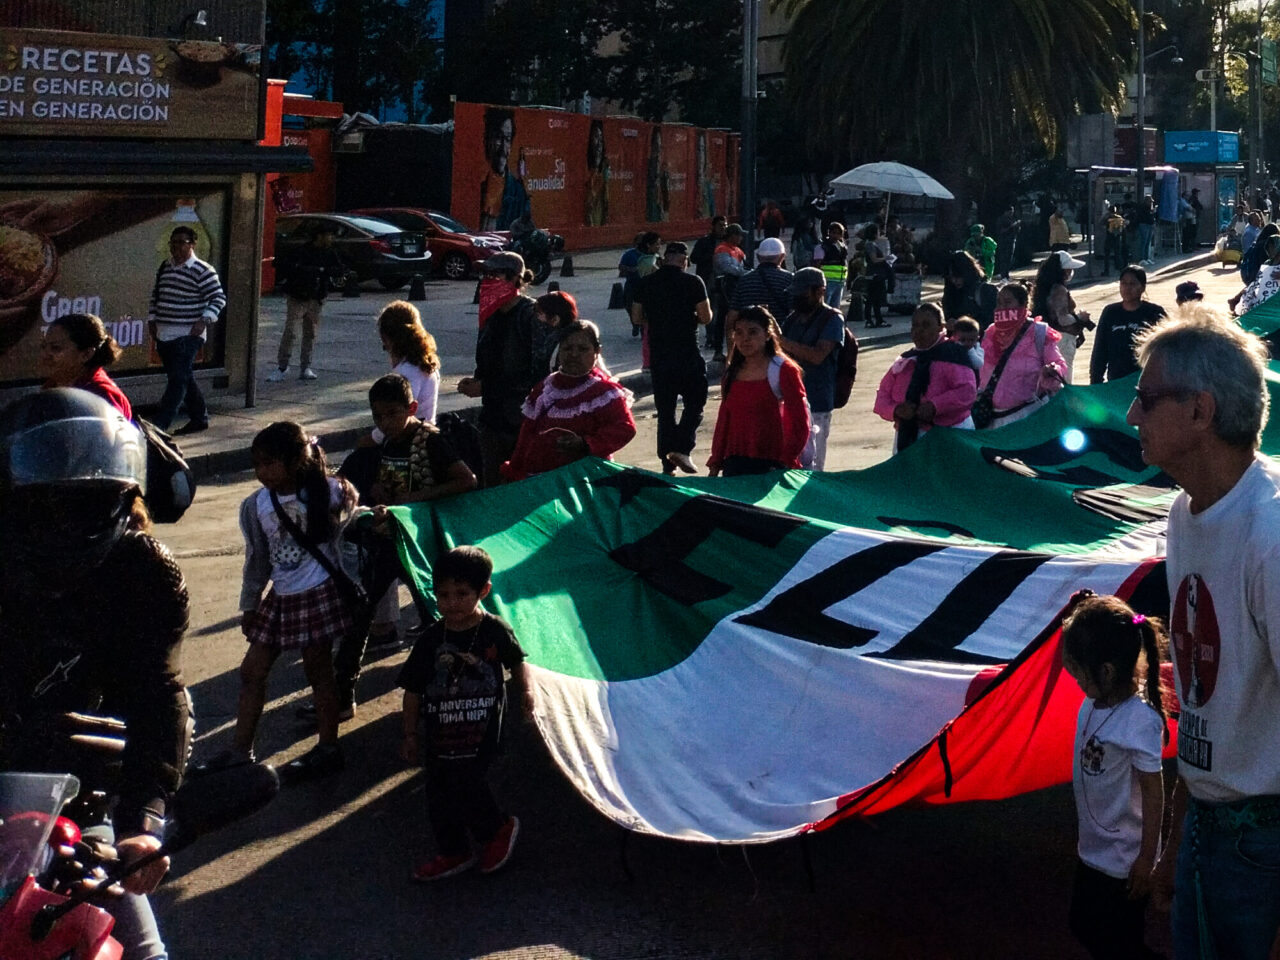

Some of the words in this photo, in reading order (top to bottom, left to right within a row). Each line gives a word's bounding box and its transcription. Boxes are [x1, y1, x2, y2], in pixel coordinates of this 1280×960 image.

[21, 46, 151, 75] RECETAS
[0, 76, 26, 93] DE
[33, 77, 170, 99] GENERACIÓN
[32, 100, 169, 121] GENERACIÓN
[438, 711, 464, 724] TOMA
